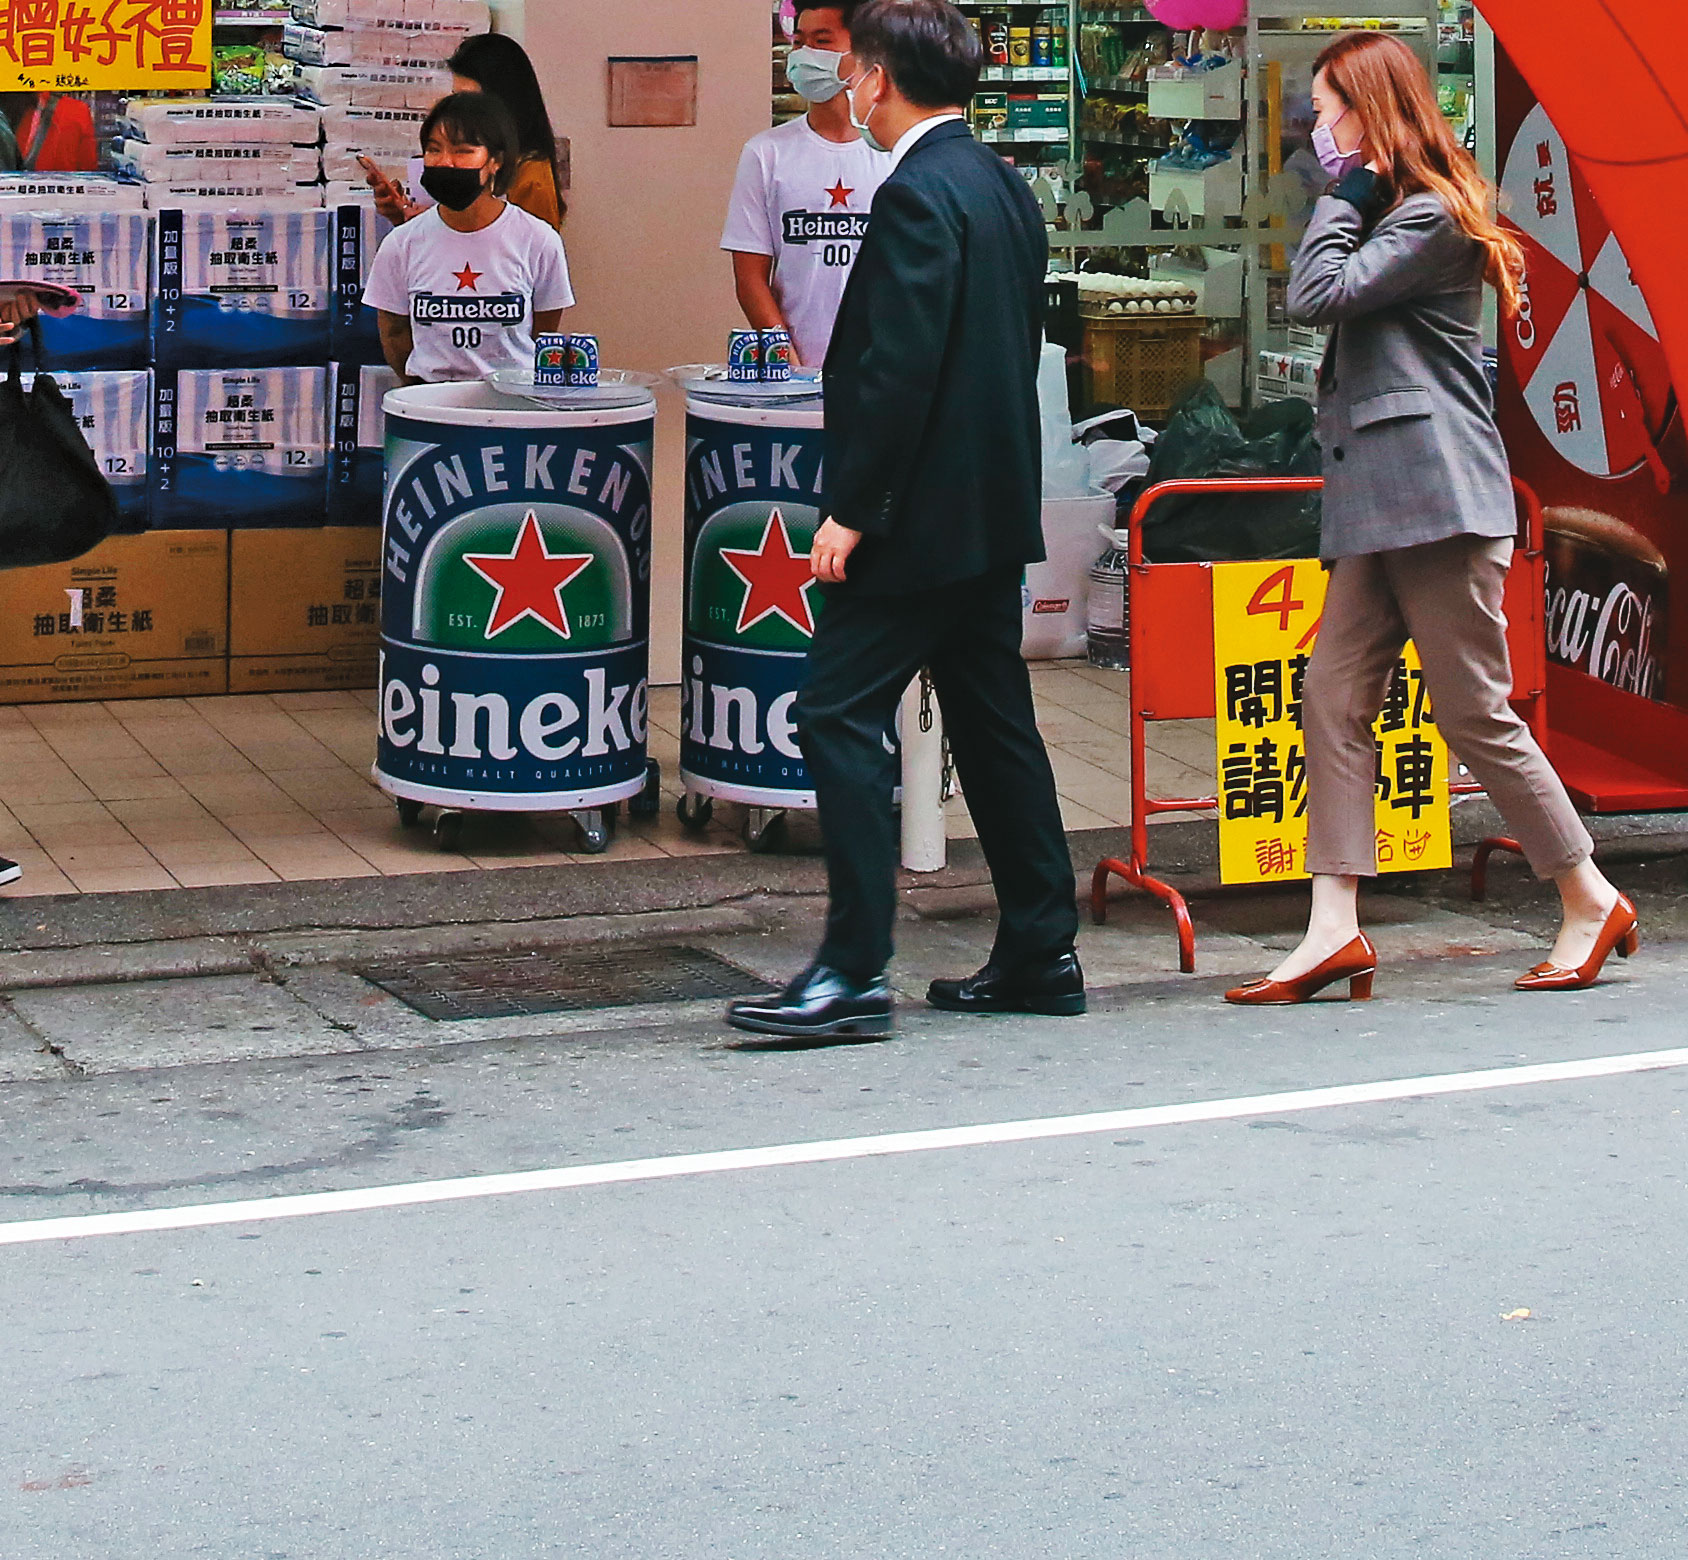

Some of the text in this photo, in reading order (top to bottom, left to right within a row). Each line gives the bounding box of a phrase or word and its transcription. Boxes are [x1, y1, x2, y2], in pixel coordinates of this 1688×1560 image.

[163, 230, 178, 275] 加量版
[341, 226, 357, 271] 加量版
[25, 251, 96, 266] 抽取衛生紙
[209, 251, 278, 266] 抽取衛生紙
[106, 294, 128, 309] 12
[289, 293, 310, 308] 12
[415, 297, 521, 321] Heineken
[158, 388, 173, 434] 加量版
[340, 383, 355, 428] 加量版
[205, 410, 274, 425] 抽取衛生紙
[285, 450, 308, 465] 12
[105, 458, 127, 473] 12
[386, 444, 632, 583] HEINEKEN
[32, 609, 154, 637] 抽取衛生紙
[448, 613, 606, 628] EST. 1873
